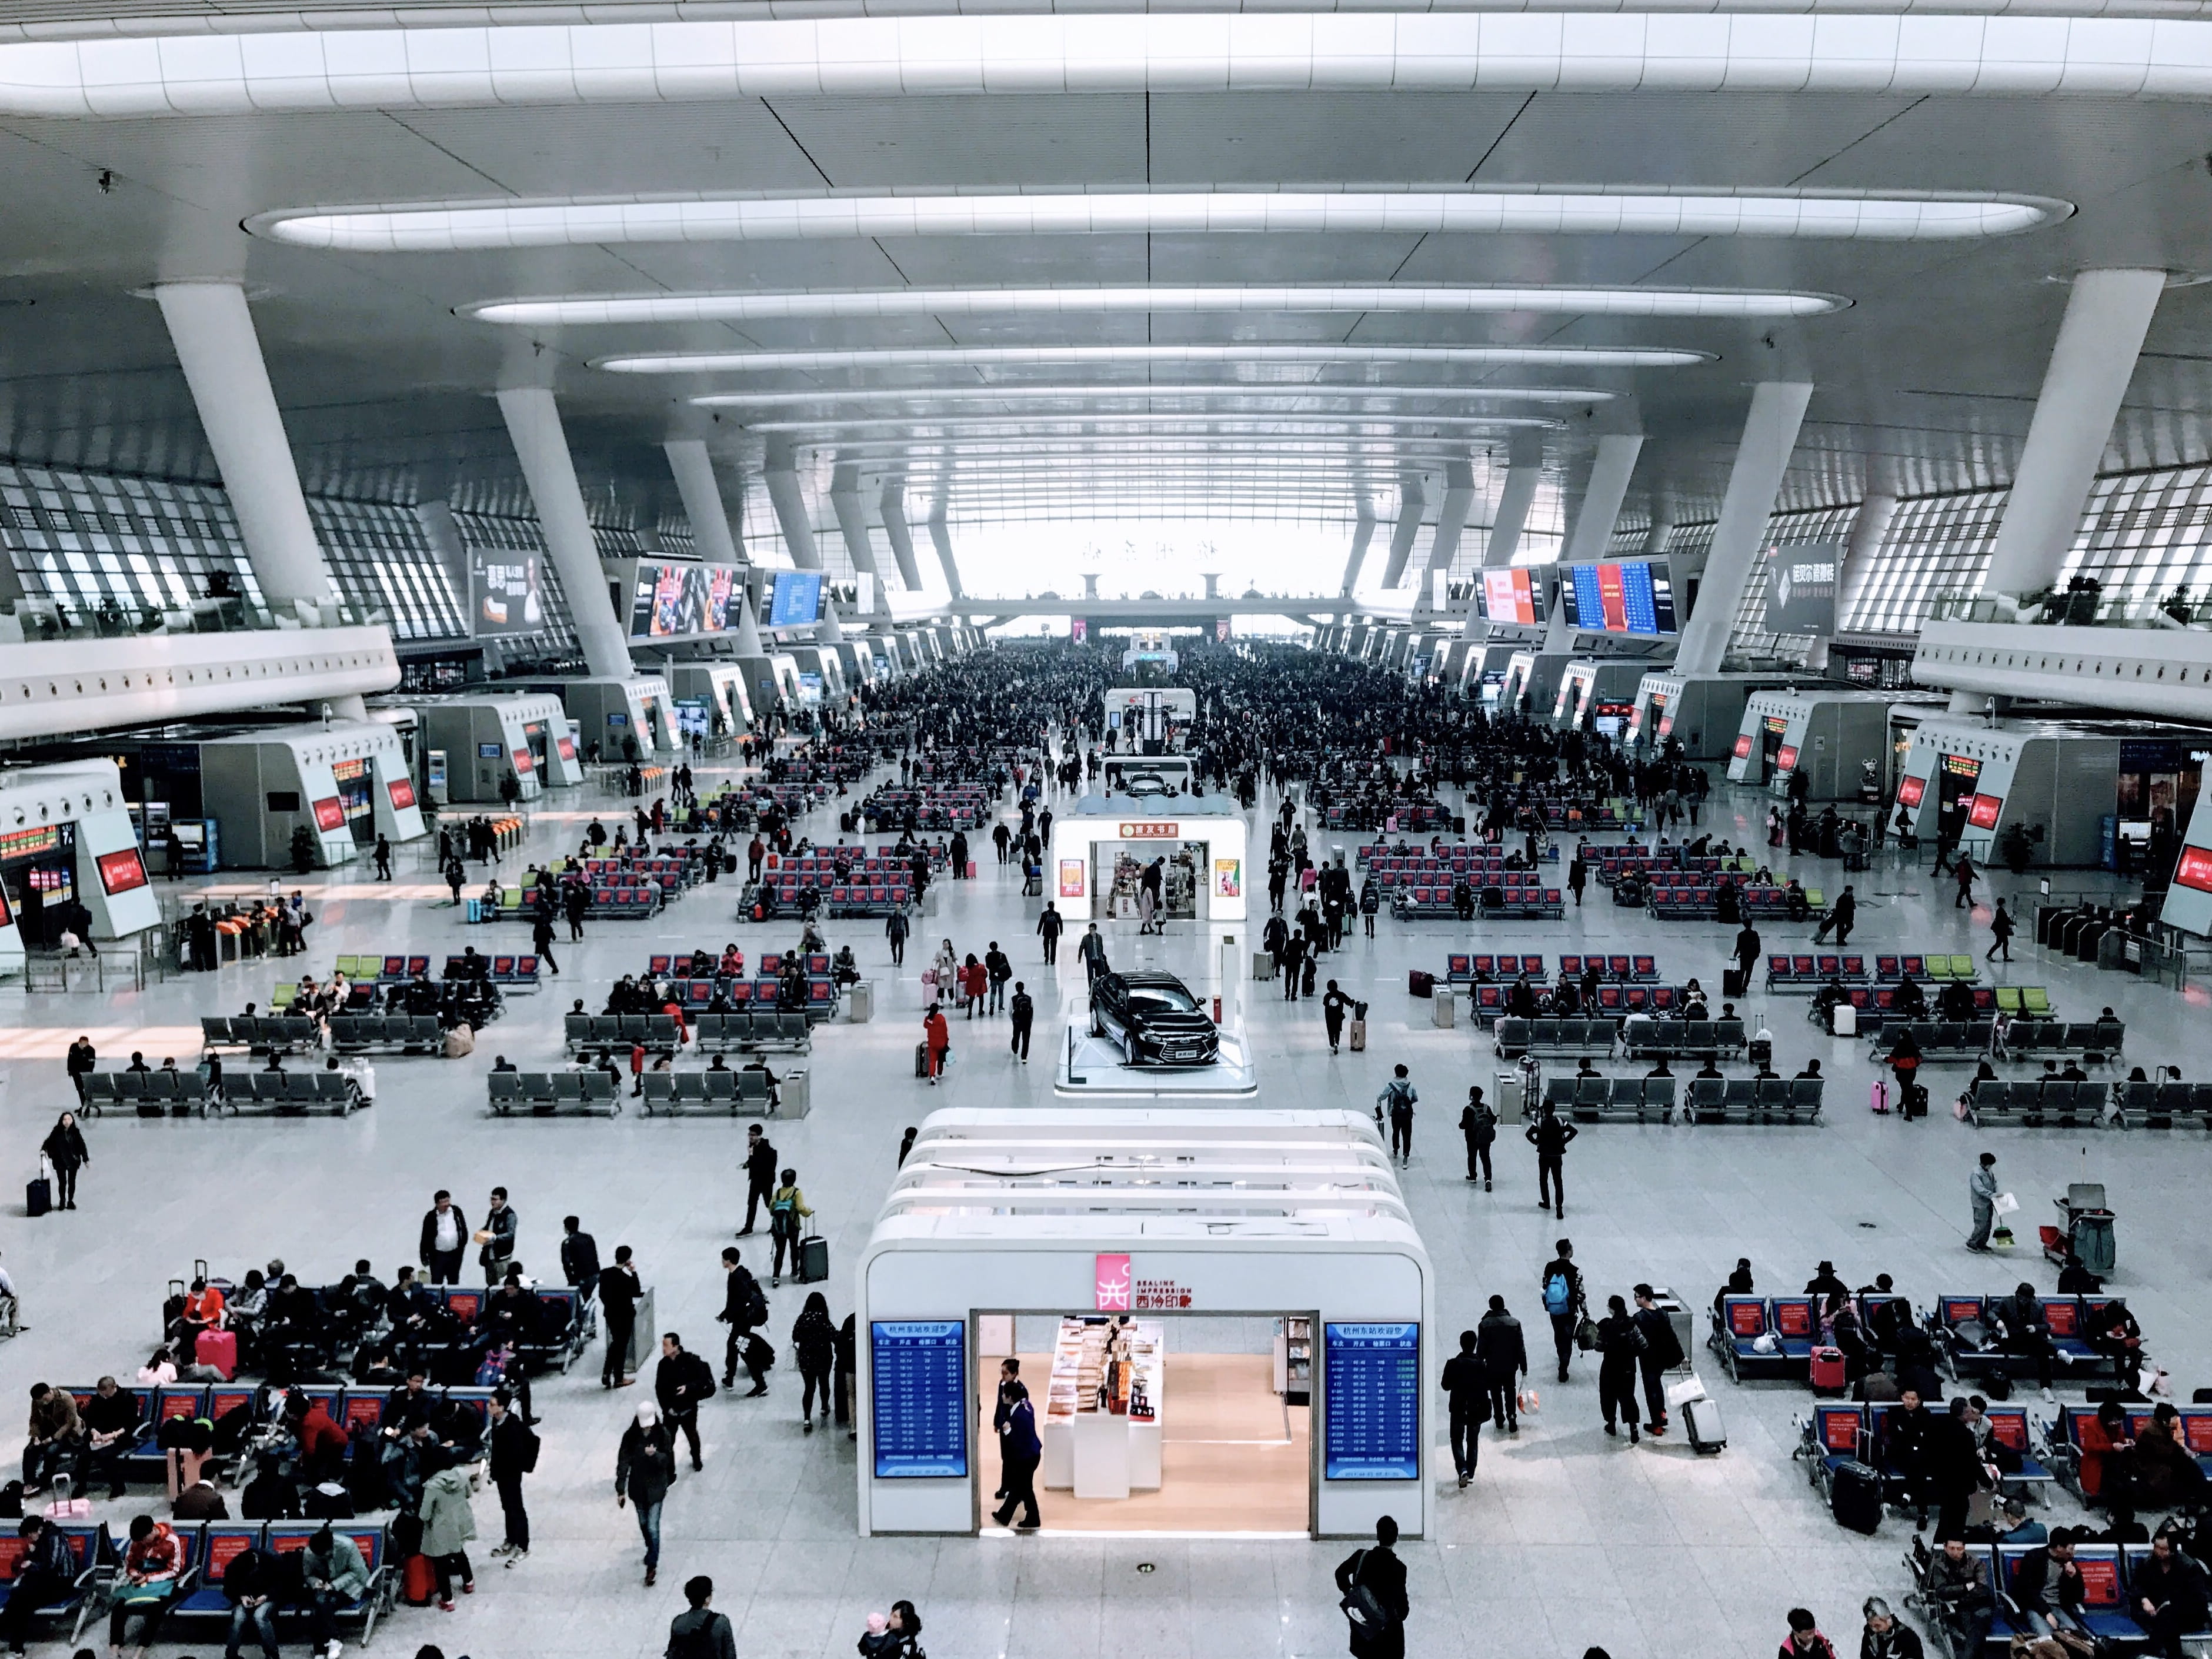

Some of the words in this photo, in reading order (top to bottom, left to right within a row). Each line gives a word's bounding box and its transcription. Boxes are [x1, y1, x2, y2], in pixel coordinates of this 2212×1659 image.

[1136, 825, 1176, 833] 旅友书屋
[1343, 1327, 1402, 1335] 杭州东站欢迎您
